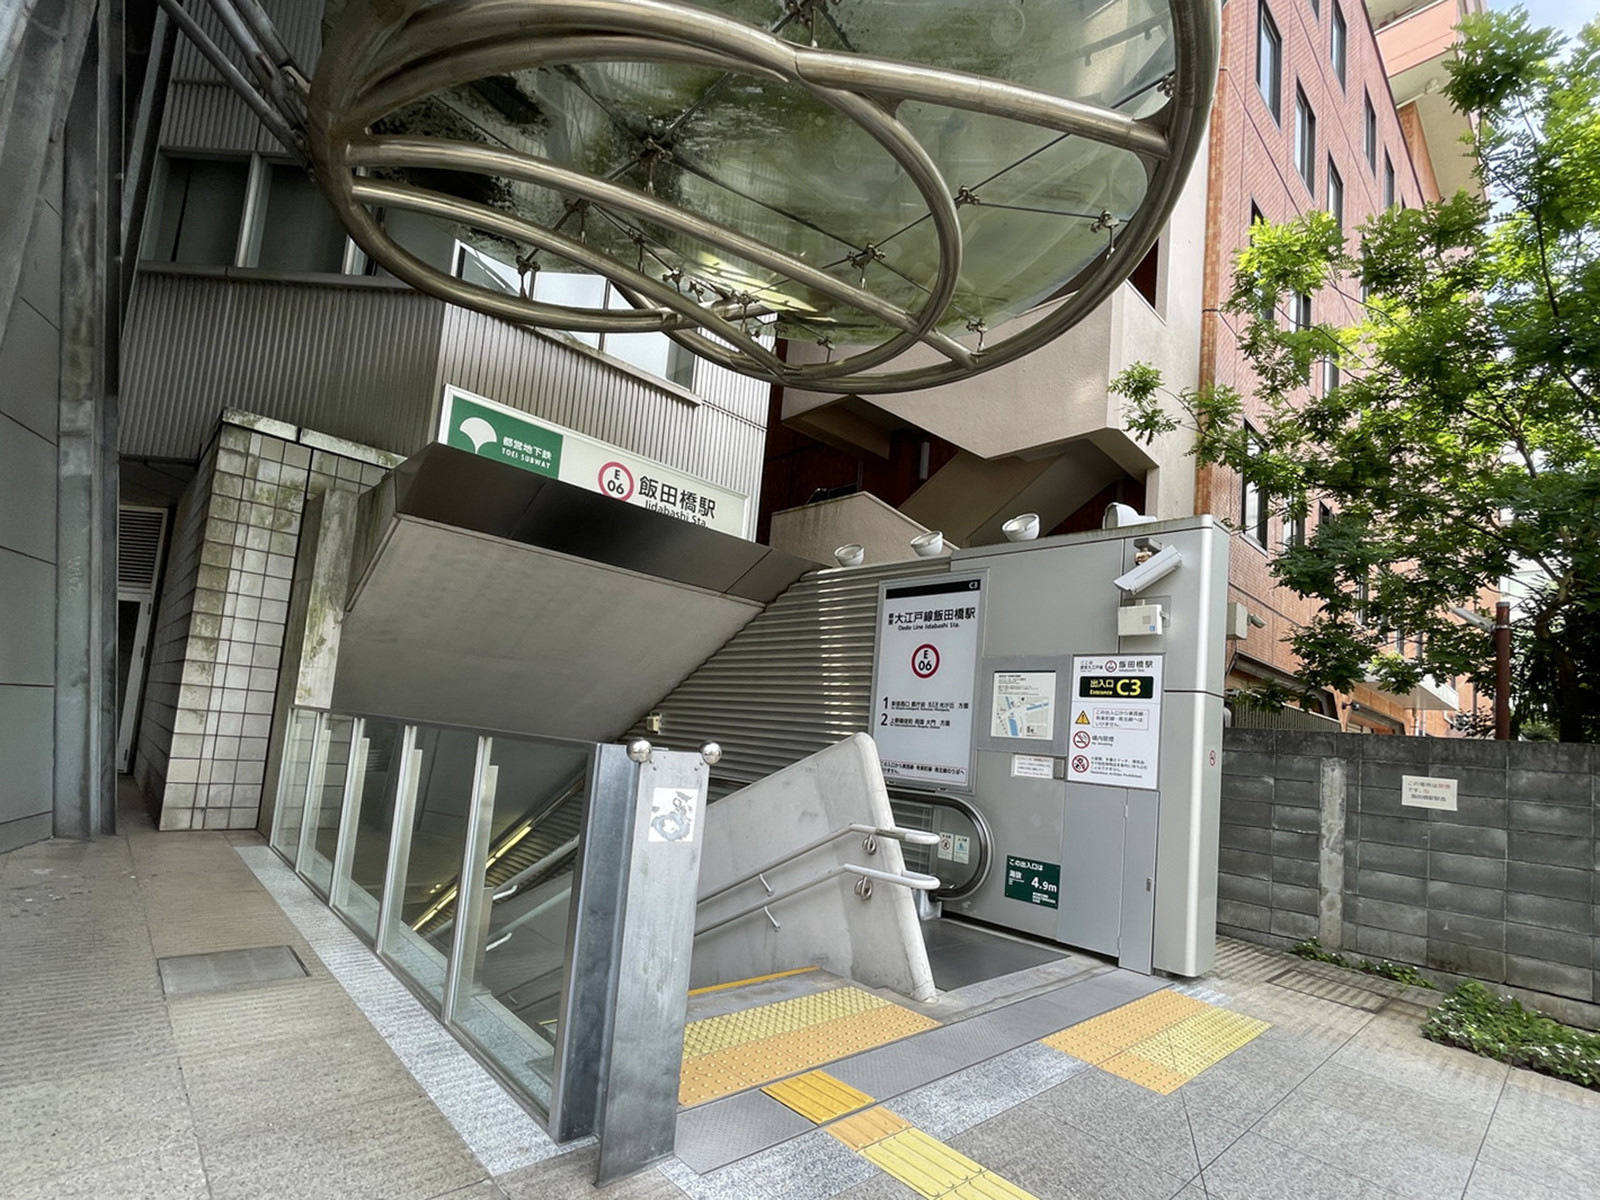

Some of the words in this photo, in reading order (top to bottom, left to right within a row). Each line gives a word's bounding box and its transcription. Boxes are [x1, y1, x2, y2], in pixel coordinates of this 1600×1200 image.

[503, 436, 552, 461] 都営地下鉄
[501, 447, 519, 459] TOEI
[520, 454, 551, 469] SUBWAY
[614, 469, 621, 480] E
[607, 480, 625, 495] 06
[638, 475, 716, 519] 飯田橋駅
[968, 581, 978, 590] C3
[923, 649, 929, 660] E
[918, 660, 932, 671] 06
[1089, 679, 1114, 689] 出入口
[1116, 678, 1142, 696] C3
[882, 696, 888, 710] 1
[880, 712, 888, 726] 2
[1009, 858, 1043, 871] この出入口は
[1031, 876, 1057, 894] 4.9m
